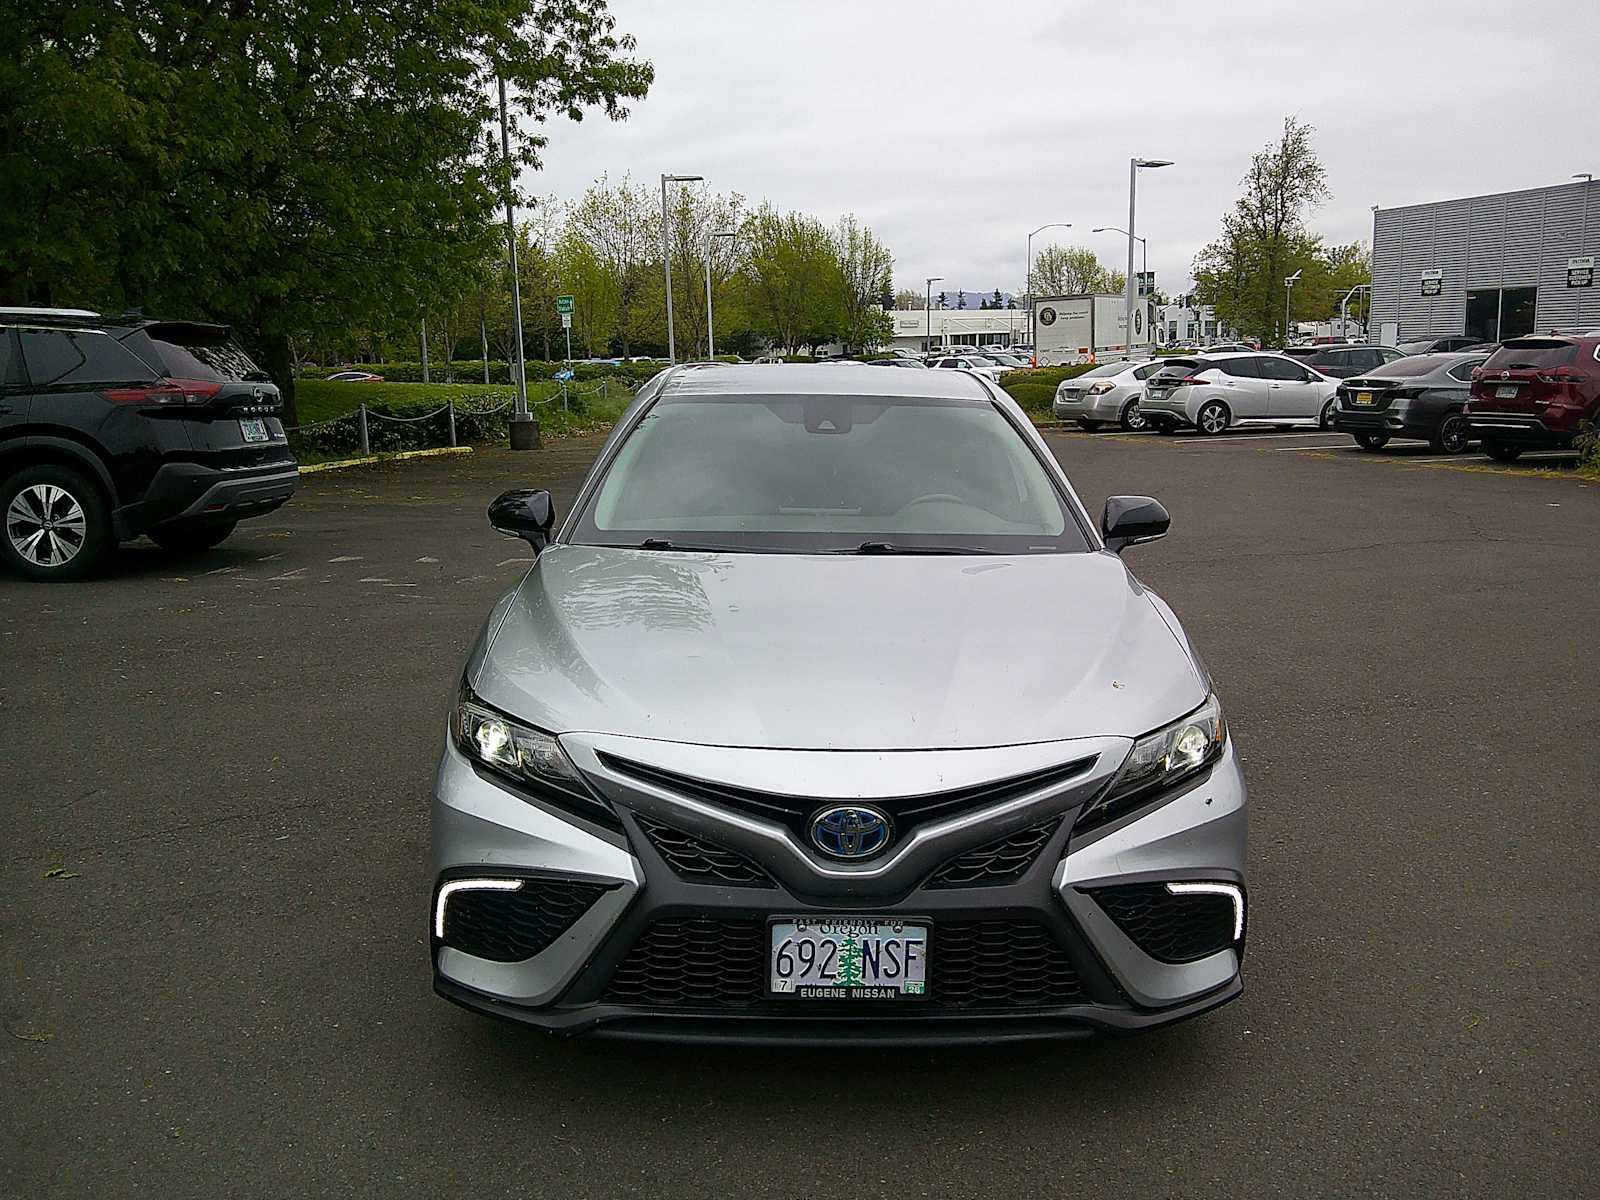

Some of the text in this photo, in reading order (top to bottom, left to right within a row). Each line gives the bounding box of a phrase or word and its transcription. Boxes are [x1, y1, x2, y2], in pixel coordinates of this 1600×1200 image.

[820, 925, 880, 938] Oregon
[776, 939, 923, 979] 692 NSF
[780, 980, 788, 991] 7
[800, 988, 895, 999] EUGENE NISSAN
